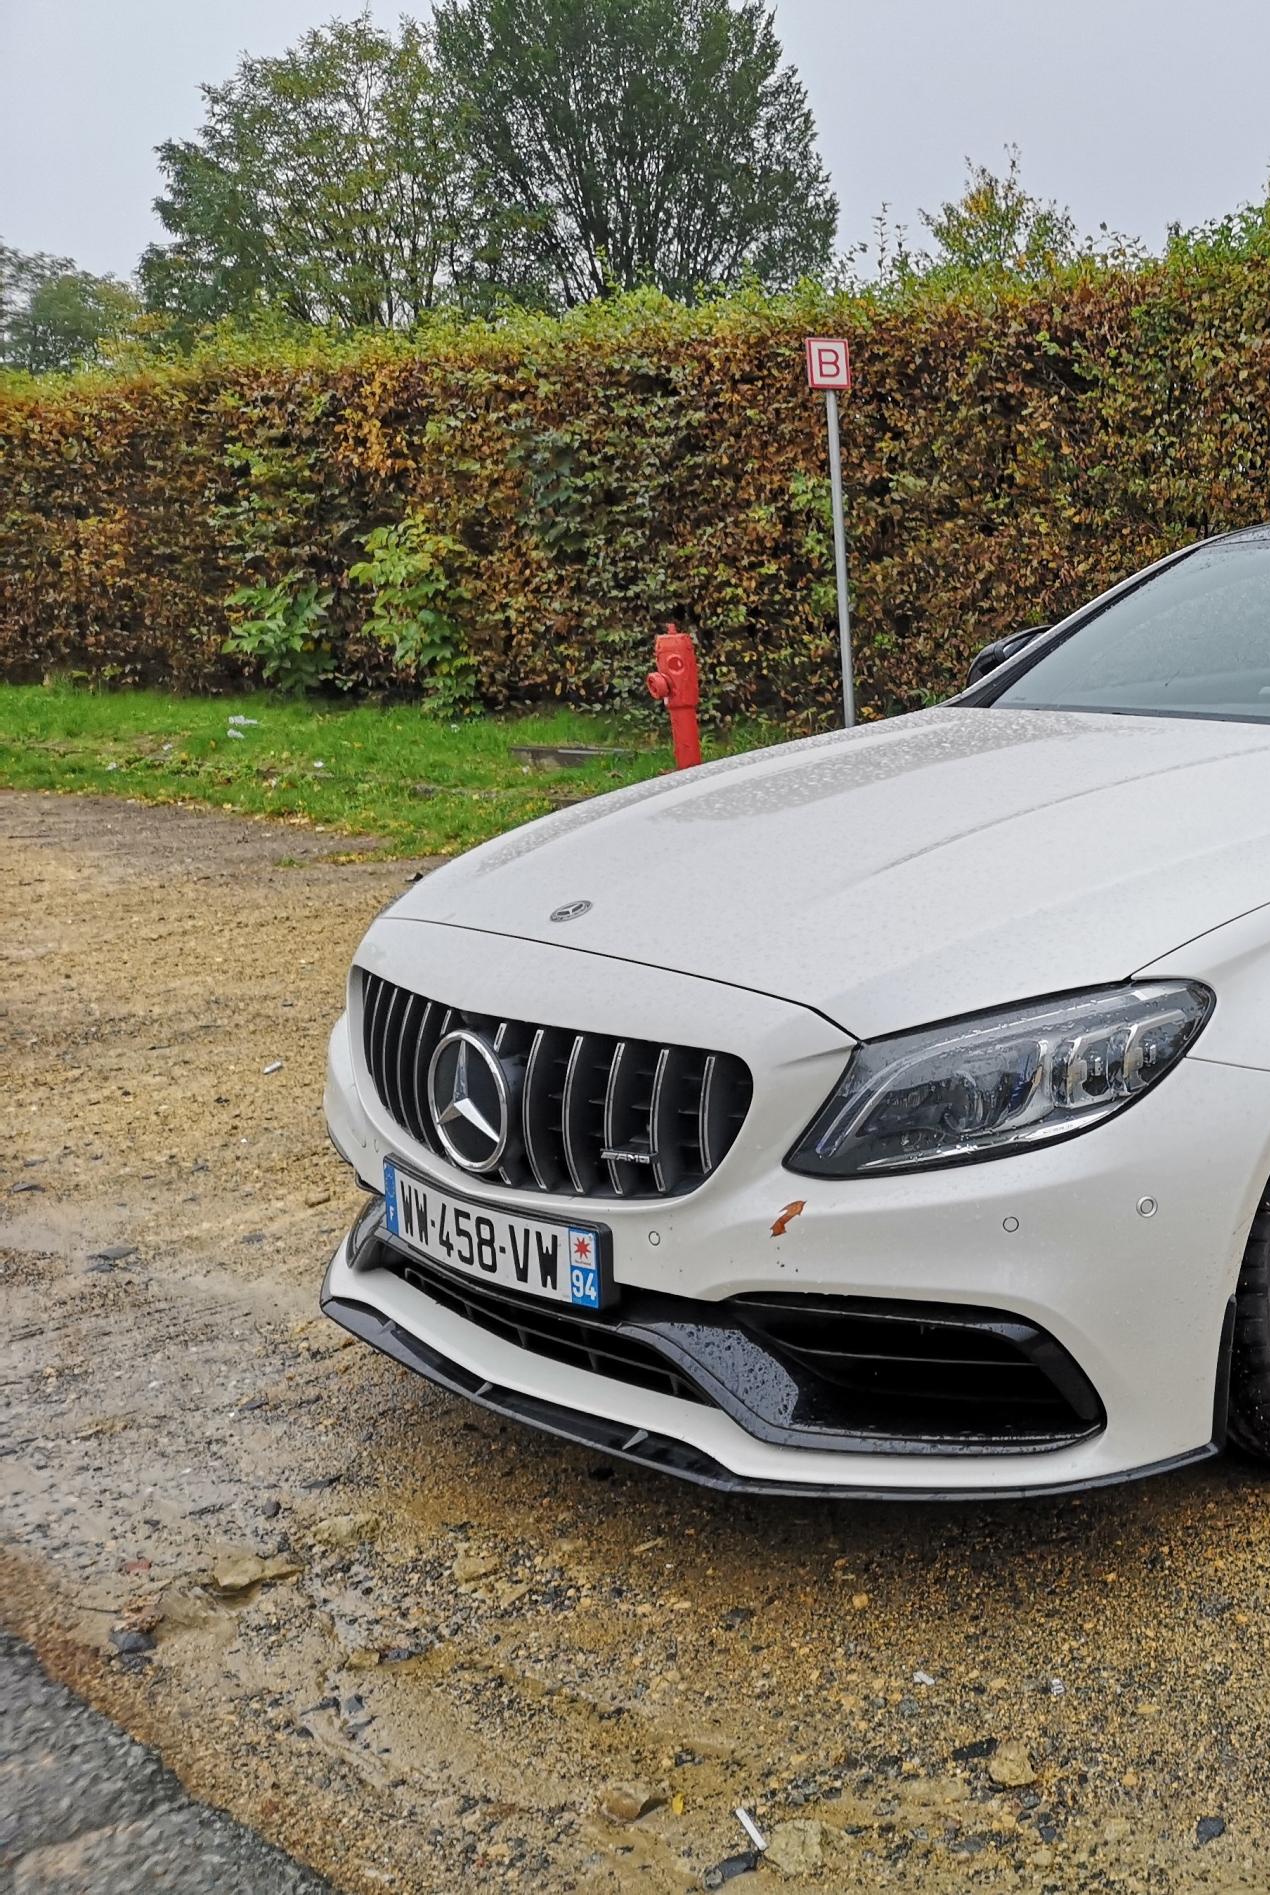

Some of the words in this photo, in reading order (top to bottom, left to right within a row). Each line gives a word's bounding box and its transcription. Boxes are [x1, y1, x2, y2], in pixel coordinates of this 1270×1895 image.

[818, 348, 841, 378] B
[389, 1205, 395, 1221] F
[400, 1180, 558, 1291] WW-458-VW
[572, 1269, 597, 1301] 94
